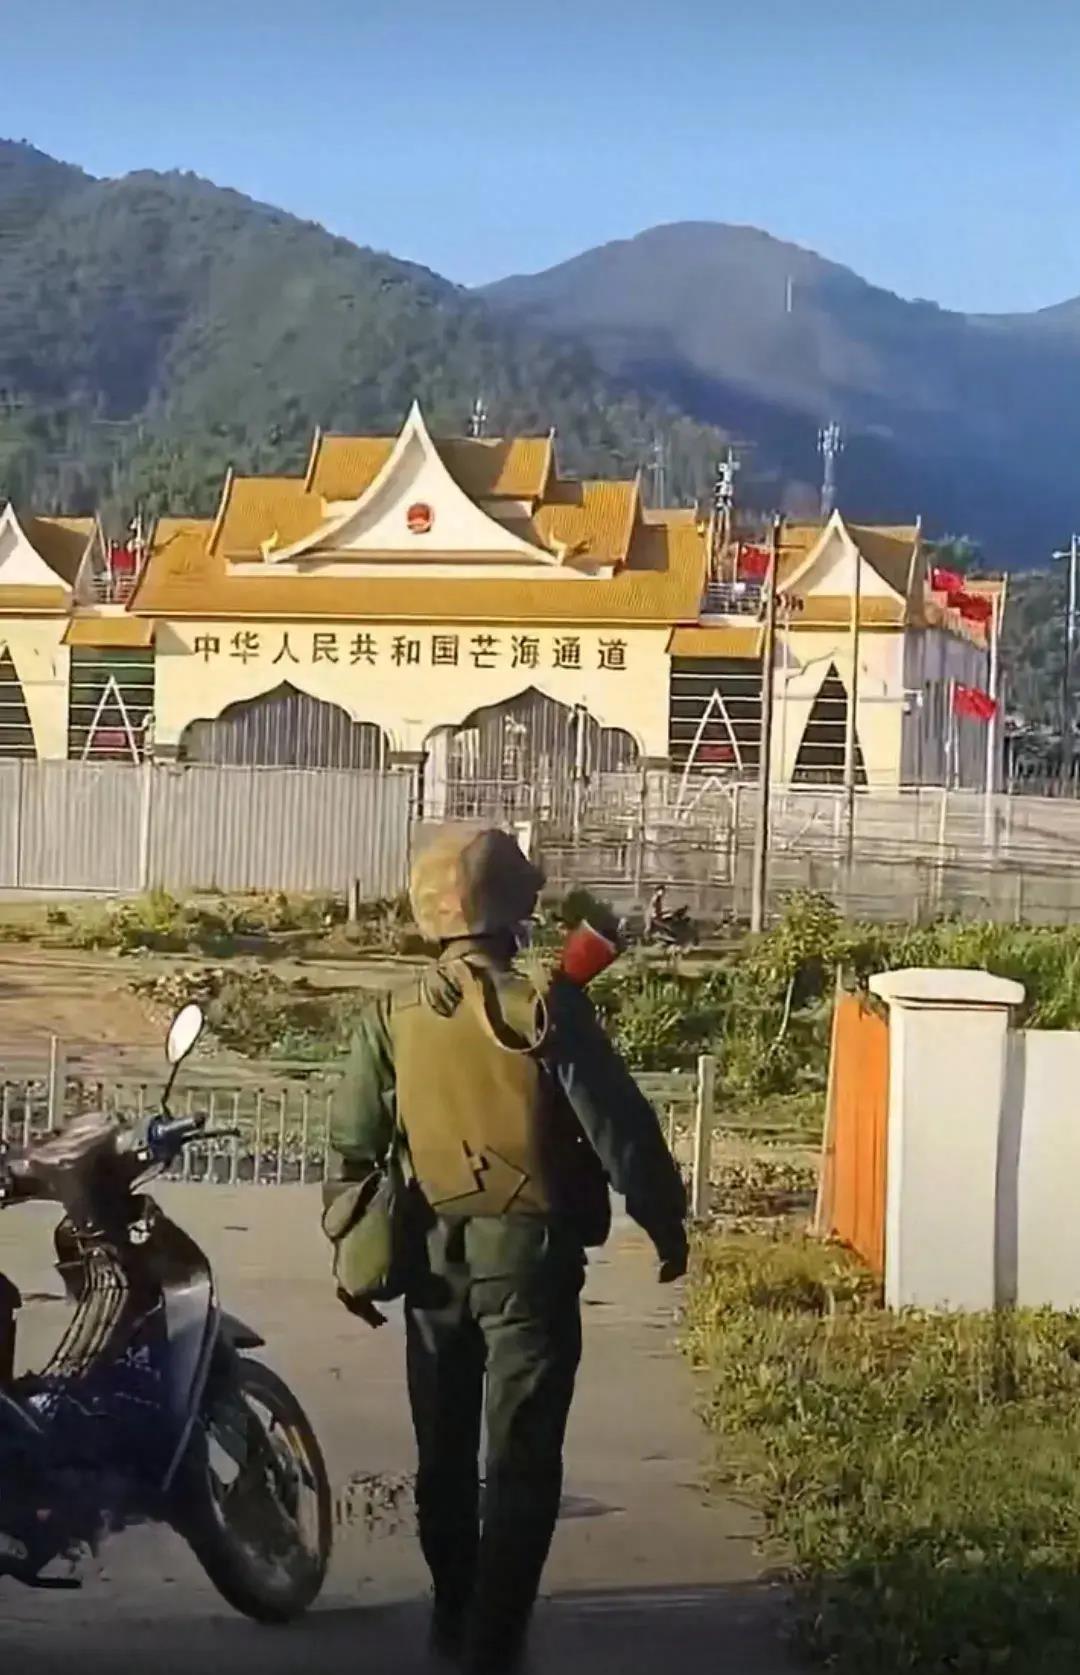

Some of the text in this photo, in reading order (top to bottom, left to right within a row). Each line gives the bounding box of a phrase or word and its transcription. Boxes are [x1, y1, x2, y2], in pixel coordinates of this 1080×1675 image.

[194, 631, 628, 671] 中华人民共和国芒海通道
